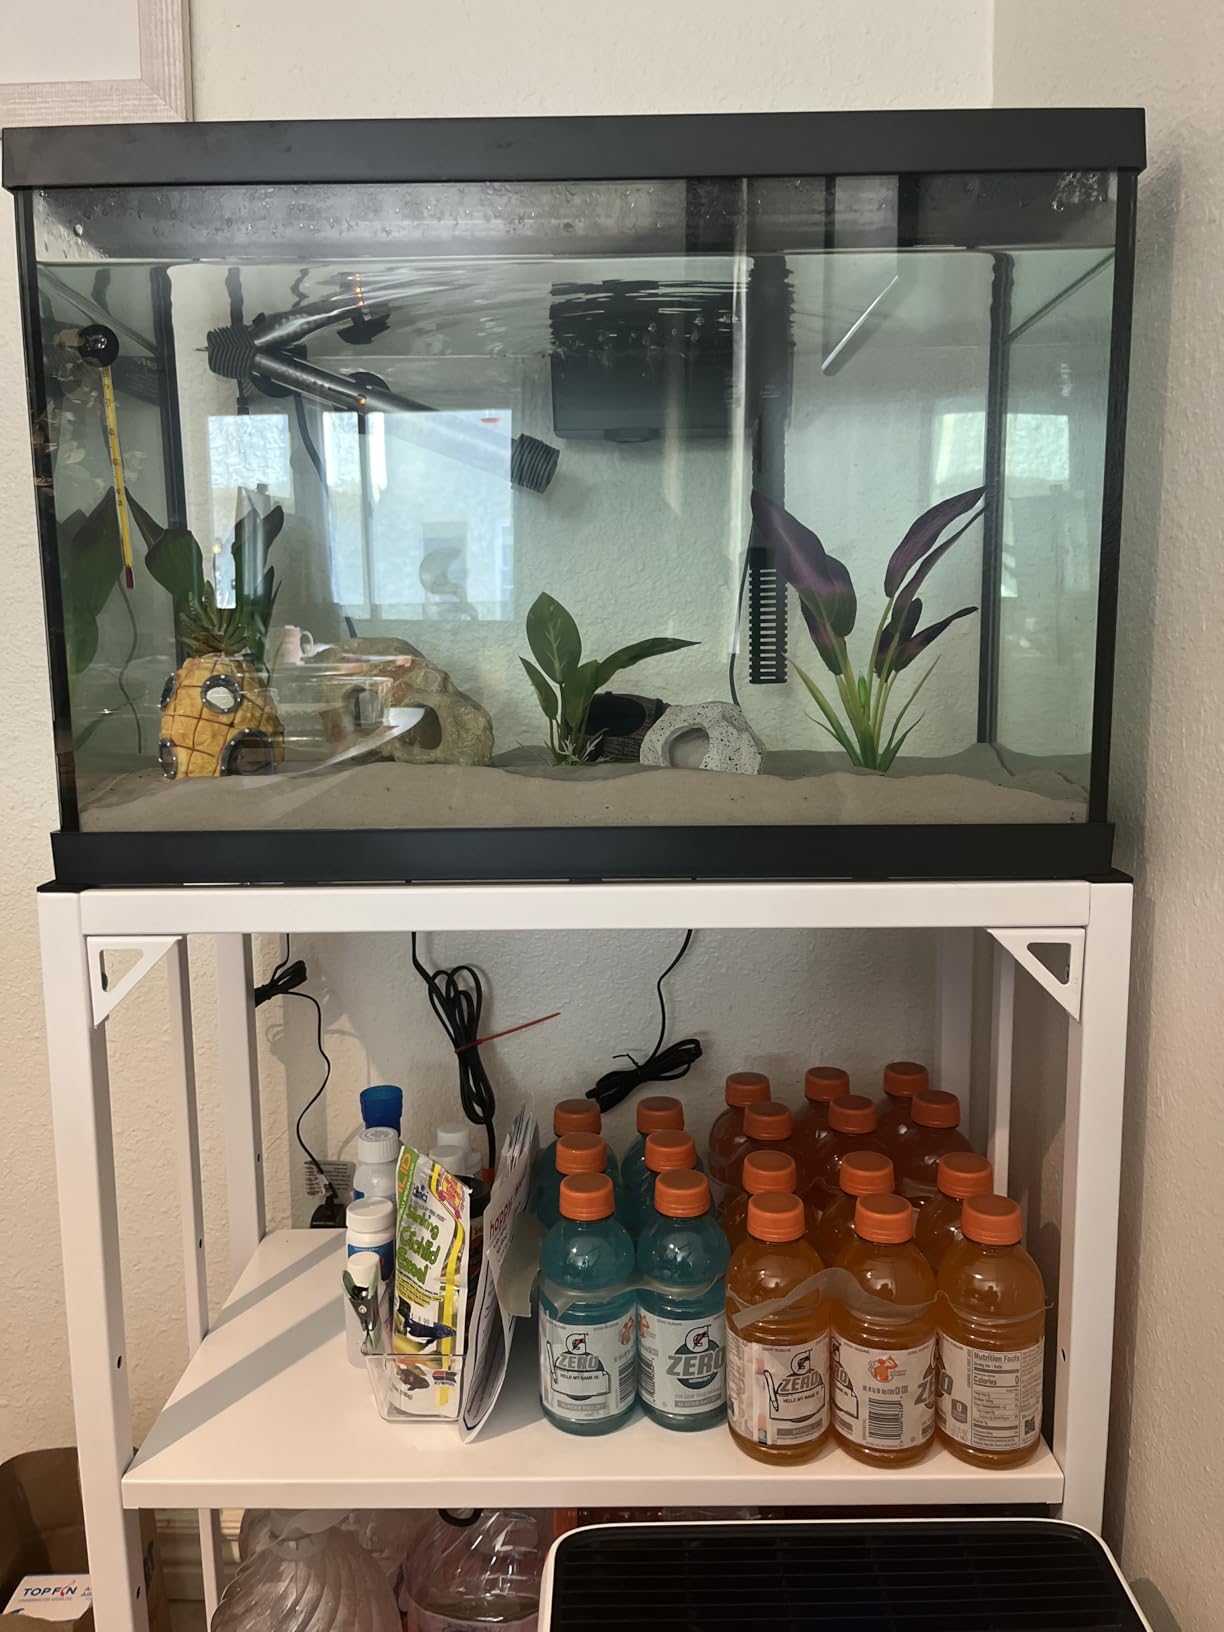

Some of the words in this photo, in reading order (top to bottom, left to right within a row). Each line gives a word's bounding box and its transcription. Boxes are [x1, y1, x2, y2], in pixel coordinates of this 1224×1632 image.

[558, 1354, 599, 1370] ZERO
[666, 1346, 726, 1377] ZERO
[973, 1352, 1003, 1362] Nutrition
[780, 1371, 820, 1392] ZERO
[973, 1375, 997, 1386] Calories
[1014, 1375, 1020, 1385] 0
[24, 1587, 52, 1597] TOP
